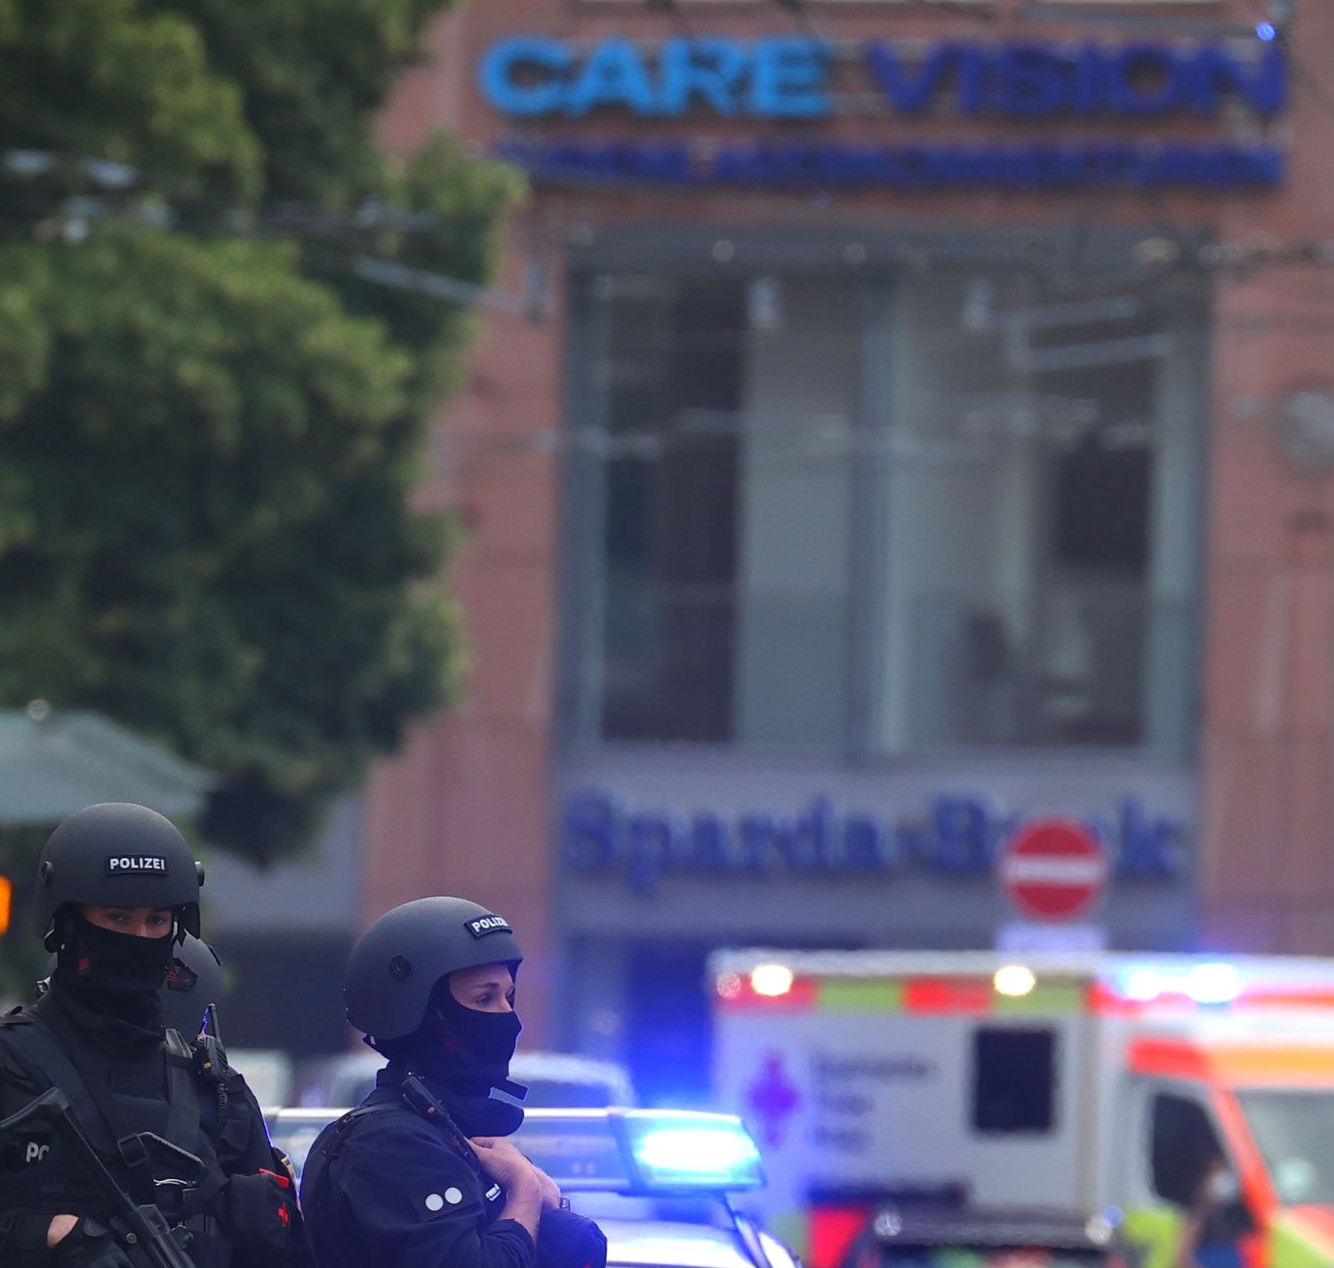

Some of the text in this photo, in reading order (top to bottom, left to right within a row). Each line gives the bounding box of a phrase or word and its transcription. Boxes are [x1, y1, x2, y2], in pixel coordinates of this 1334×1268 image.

[479, 36, 1287, 117] CARE VISION
[109, 857, 166, 871] POLIZEI
[565, 788, 1182, 898] Sparda-Bk
